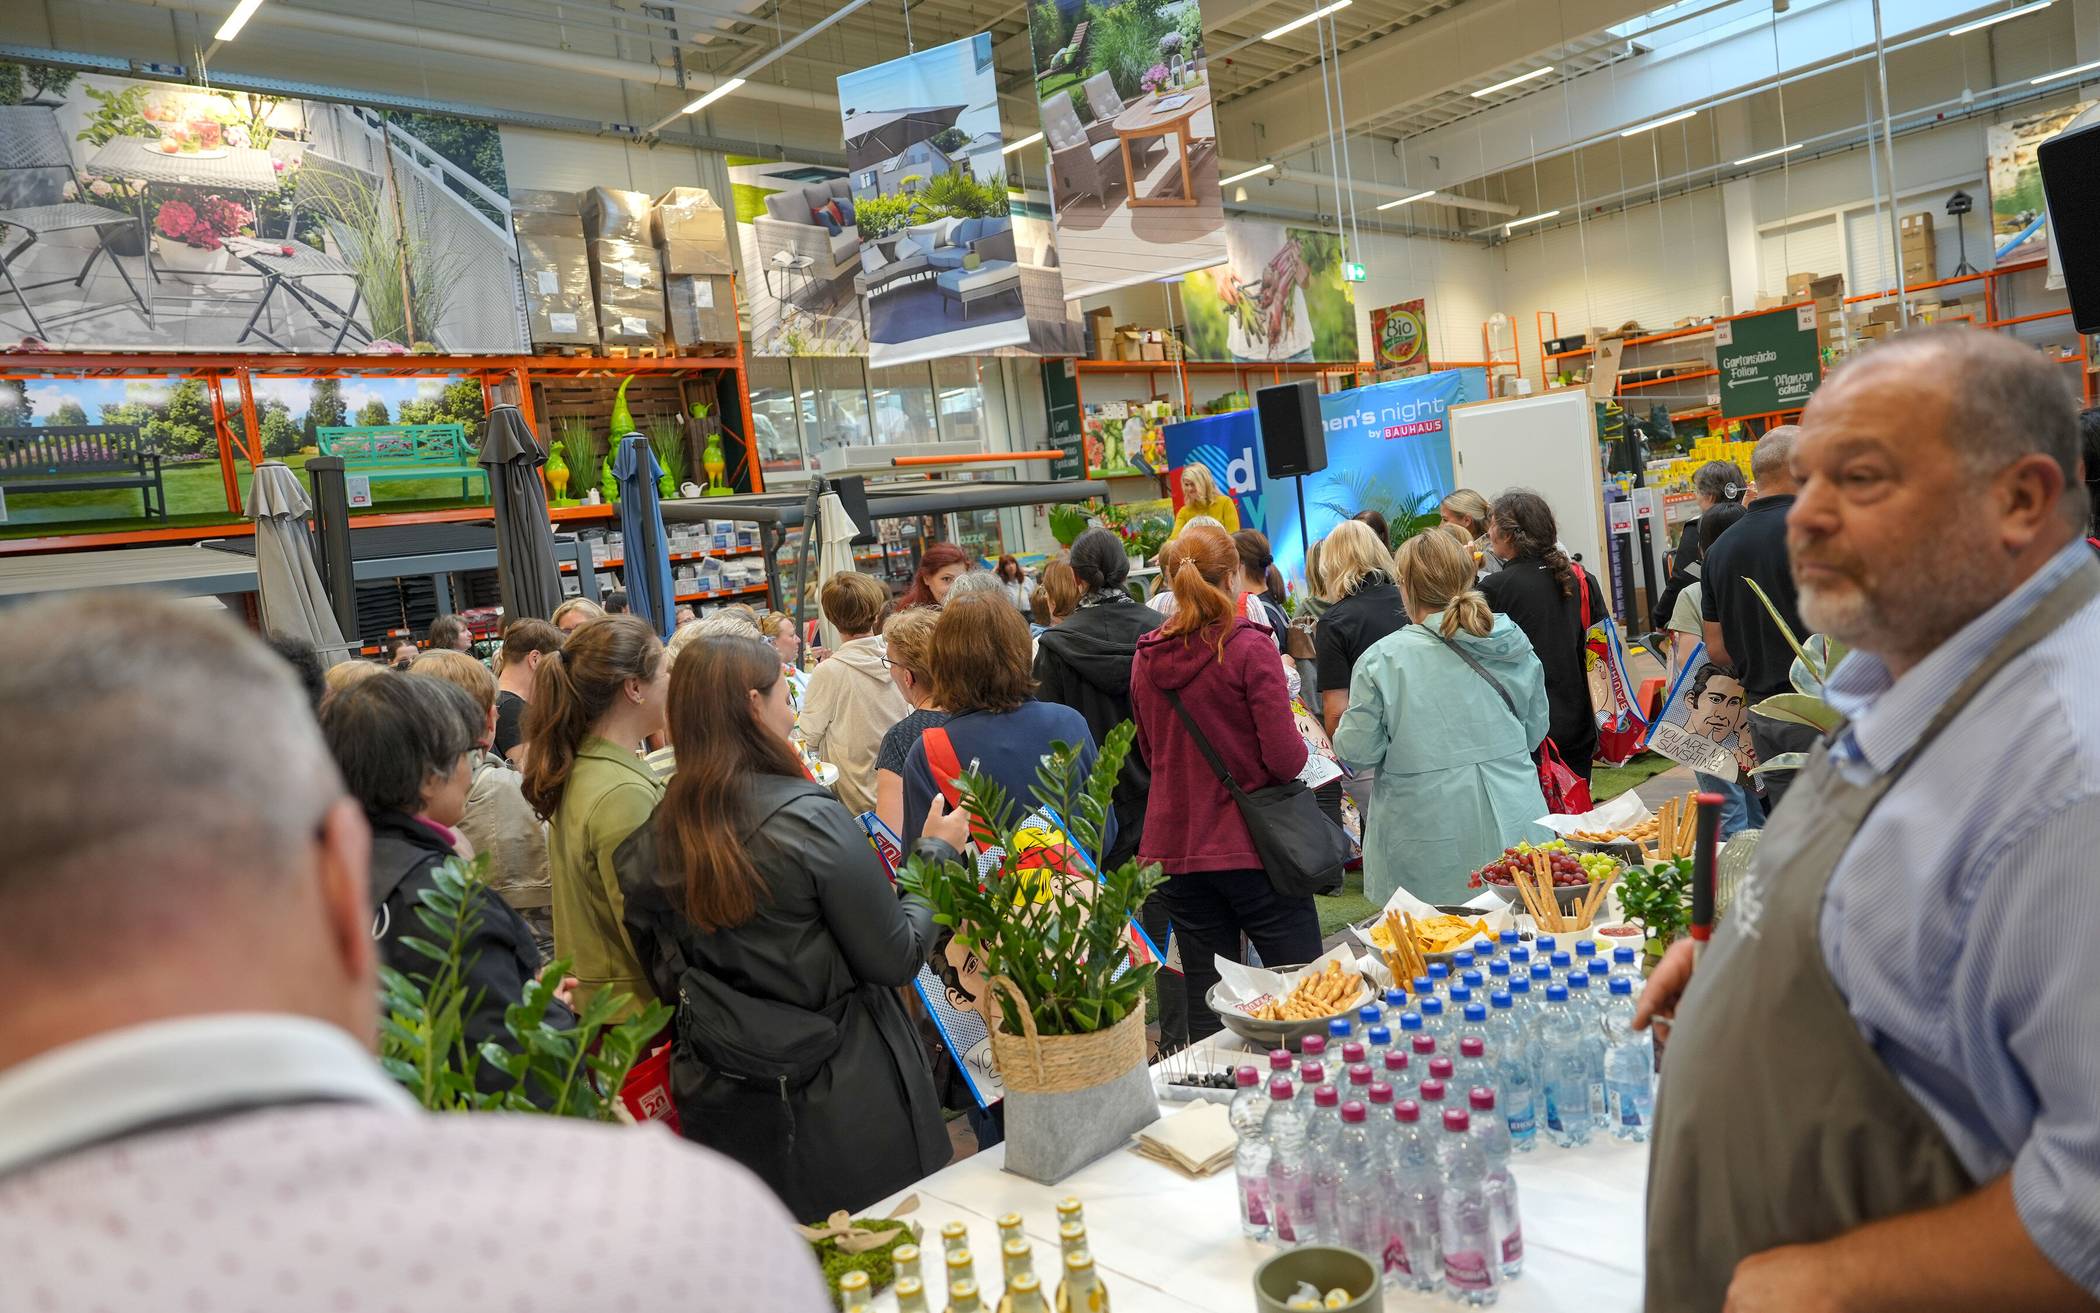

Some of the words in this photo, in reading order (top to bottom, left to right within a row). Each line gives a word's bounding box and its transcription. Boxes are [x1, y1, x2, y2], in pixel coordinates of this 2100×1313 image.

[1386, 318, 1413, 338] Bio
[1381, 397, 1445, 423] night
[1368, 429, 1382, 439] by
[1384, 420, 1442, 439] BAUHAUS
[1658, 725, 1684, 743] YOU
[1680, 738, 1709, 756] ARE
[1709, 748, 1727, 761] MY
